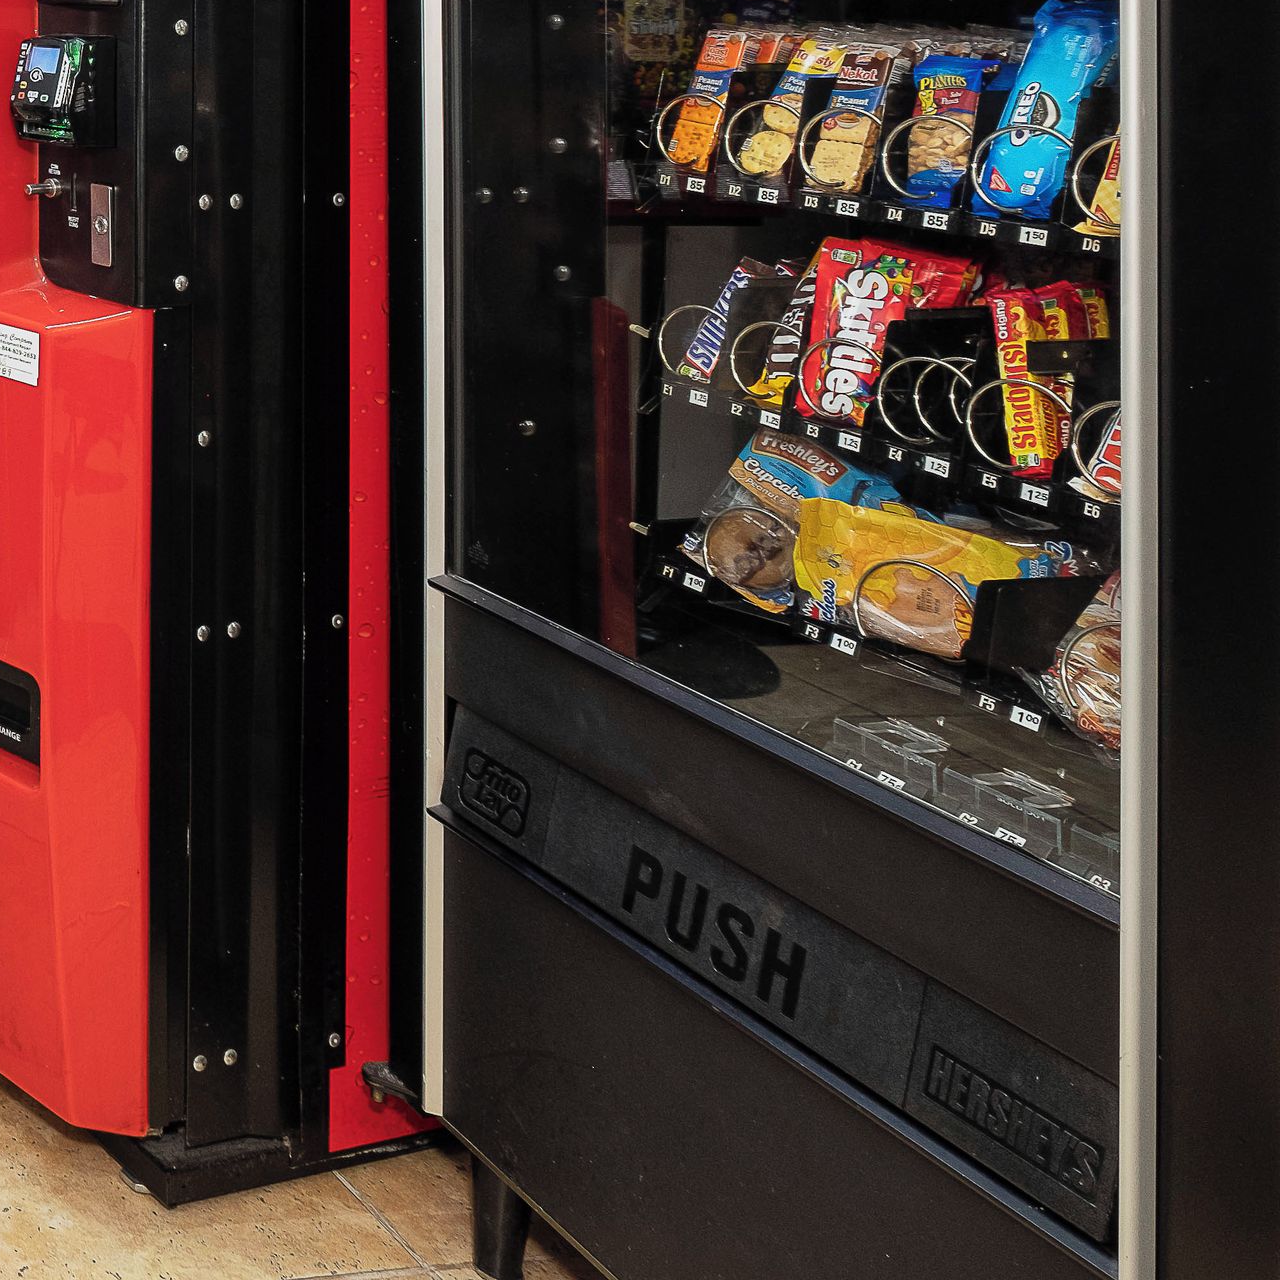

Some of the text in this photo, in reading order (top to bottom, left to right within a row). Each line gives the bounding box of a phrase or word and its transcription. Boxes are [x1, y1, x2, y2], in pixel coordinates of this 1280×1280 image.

[704, 44, 729, 56] Toast
[840, 65, 878, 81] Nekot
[695, 83, 719, 93] Butter
[697, 76, 724, 86] Peanut
[920, 75, 967, 90] PLANTERS
[837, 94, 869, 107] Peanut
[1010, 81, 1041, 147] OREO
[659, 174, 671, 186] D1
[728, 184, 742, 196] D2
[804, 196, 818, 208] D3
[887, 208, 903, 221] D4
[979, 223, 997, 236] D5
[1082, 238, 1101, 252] D6
[995, 298, 1008, 340] Original
[821, 268, 889, 418] Skittles
[662, 383, 673, 395] E1
[998, 342, 1040, 450] Starburst
[730, 404, 743, 416] E2
[806, 425, 819, 437] E3
[760, 433, 840, 478] Freshley's
[888, 448, 903, 462] E4
[981, 475, 997, 488] E5
[745, 477, 780, 502] Peanut
[1083, 503, 1101, 518] E6
[662, 565, 674, 578] F1
[804, 624, 819, 639] F3
[978, 695, 997, 712] F5
[1088, 875, 1112, 891] G3
[622, 844, 808, 1020] PUSH
[930, 1049, 1100, 1196] HERSHEY'S
